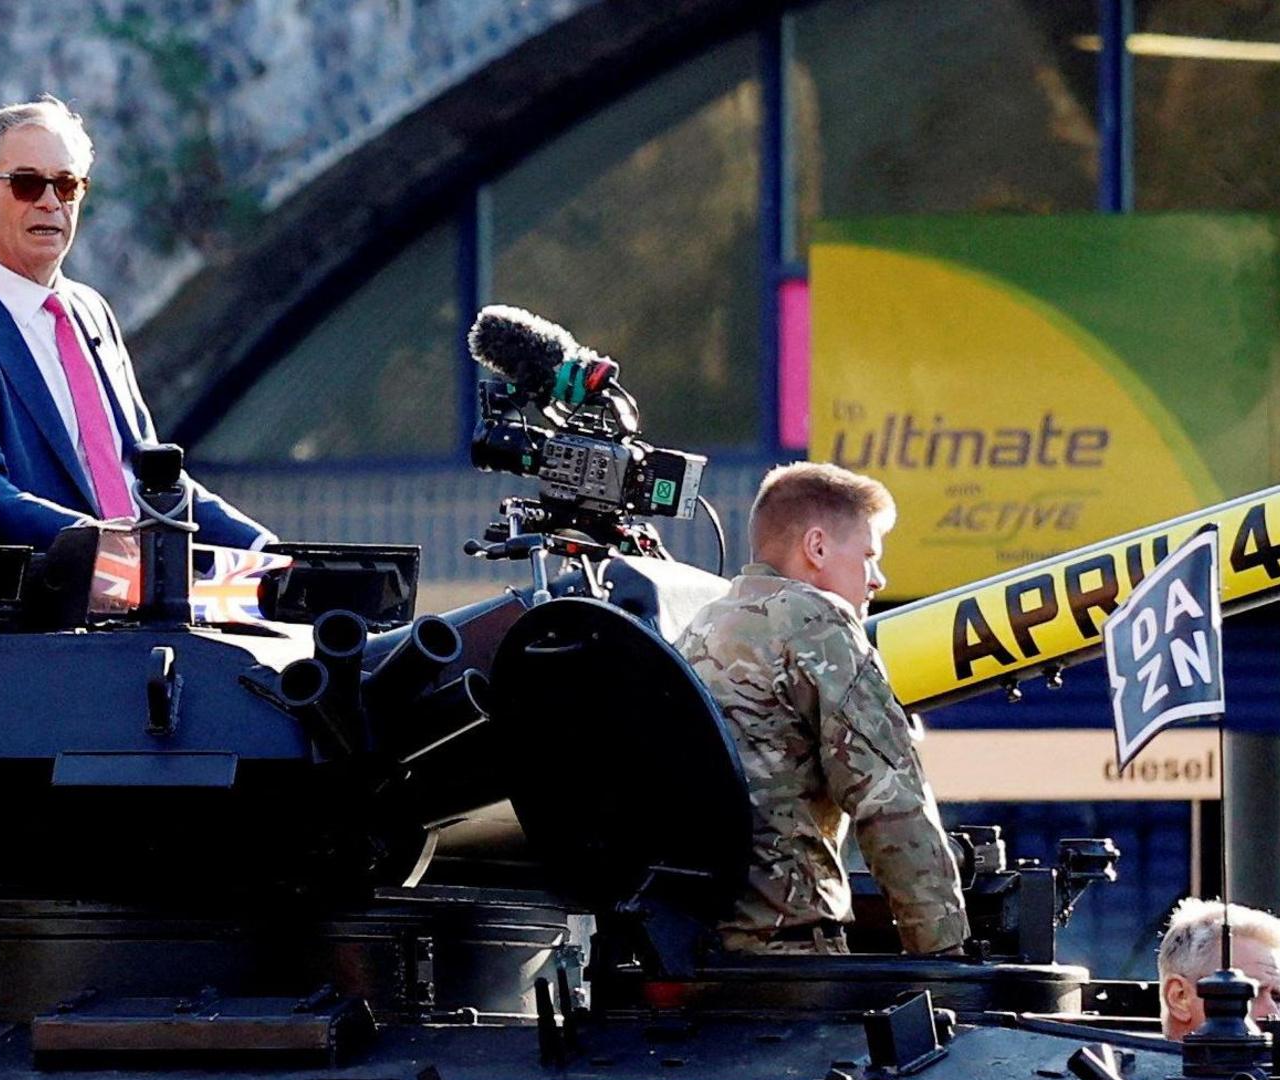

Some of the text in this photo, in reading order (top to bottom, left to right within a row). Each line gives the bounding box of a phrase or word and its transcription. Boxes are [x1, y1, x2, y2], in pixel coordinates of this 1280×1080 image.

[833, 409, 1110, 469] ultimate
[936, 501, 1086, 531] ACTIVE
[953, 535, 1169, 680] APRI
[1131, 578, 1204, 662] DA
[1137, 630, 1212, 714] ZN
